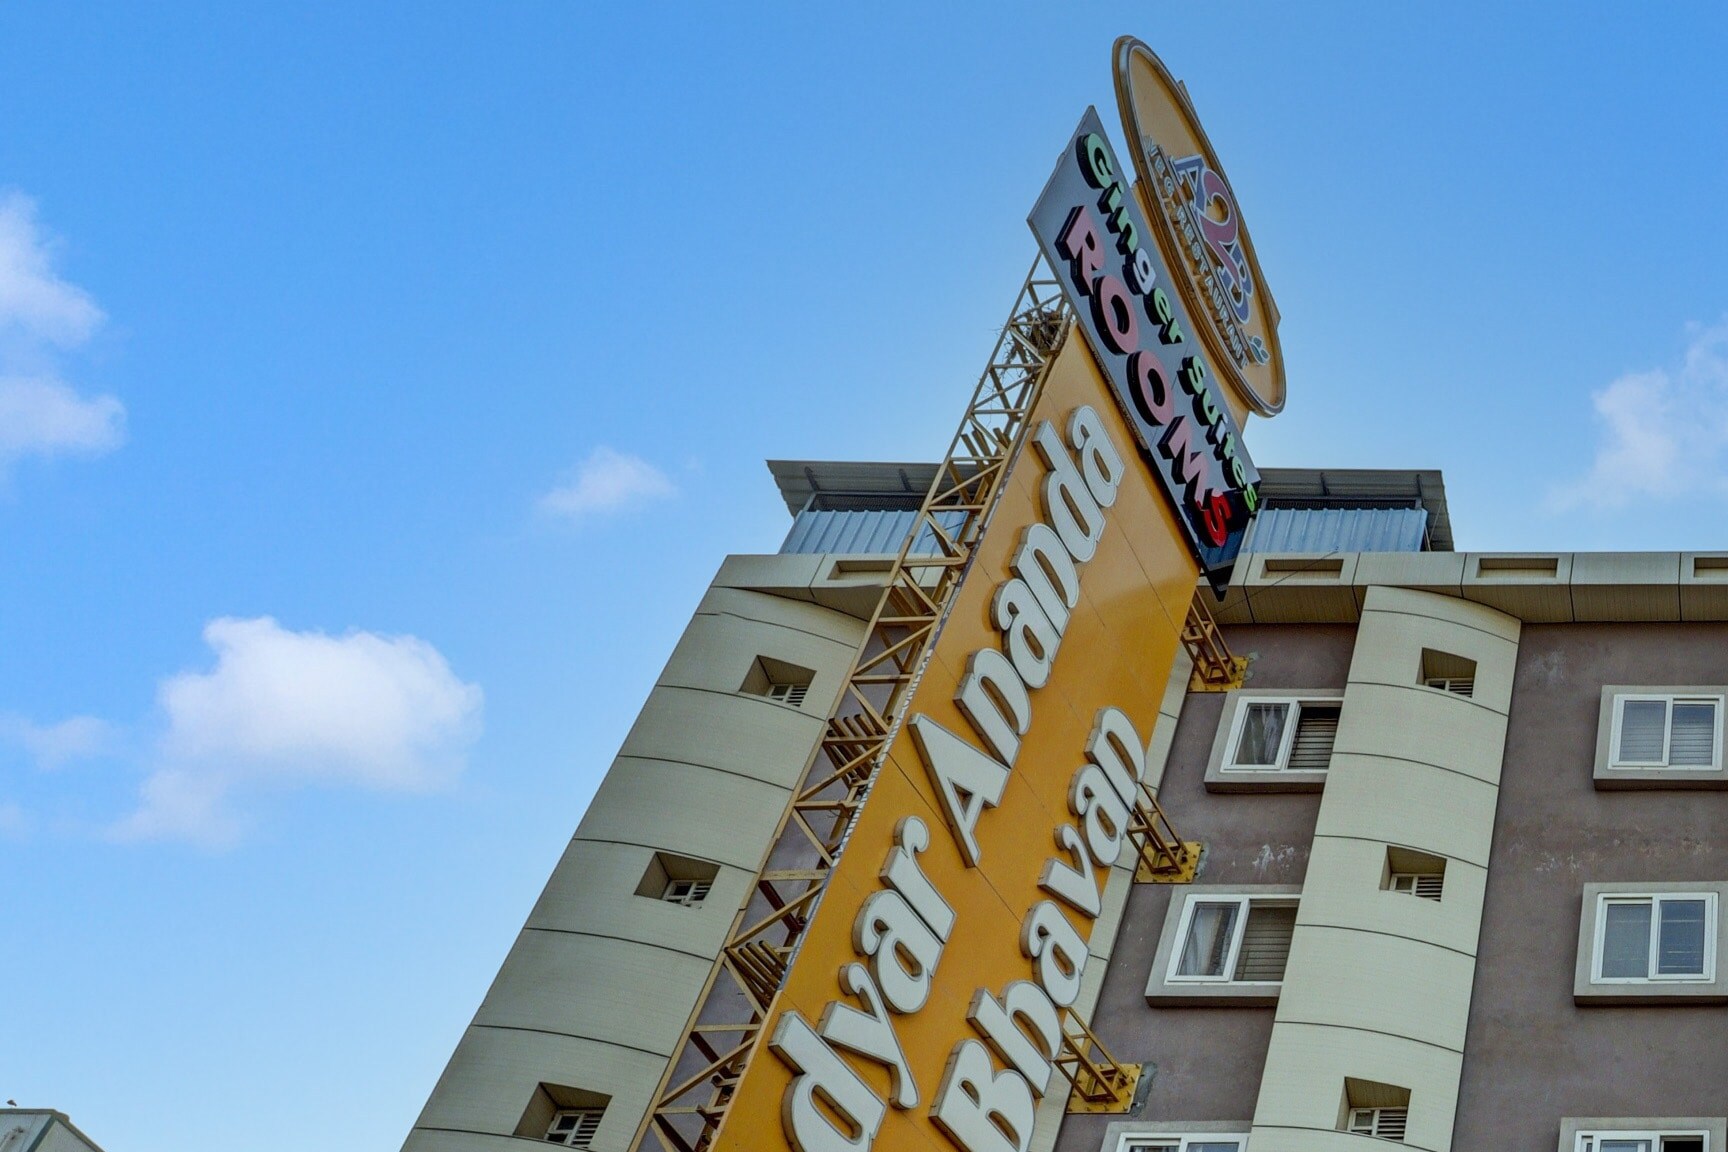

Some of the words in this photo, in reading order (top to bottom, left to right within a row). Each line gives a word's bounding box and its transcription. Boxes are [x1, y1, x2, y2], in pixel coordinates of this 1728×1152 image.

[1055, 204, 1232, 548] ROOMS
[1078, 132, 1185, 345] Ginger
[1178, 355, 1258, 512] Suites
[1169, 154, 1254, 324] A2B
[1176, 204, 1249, 370] RESTAURANT
[908, 403, 1126, 868] Ananda
